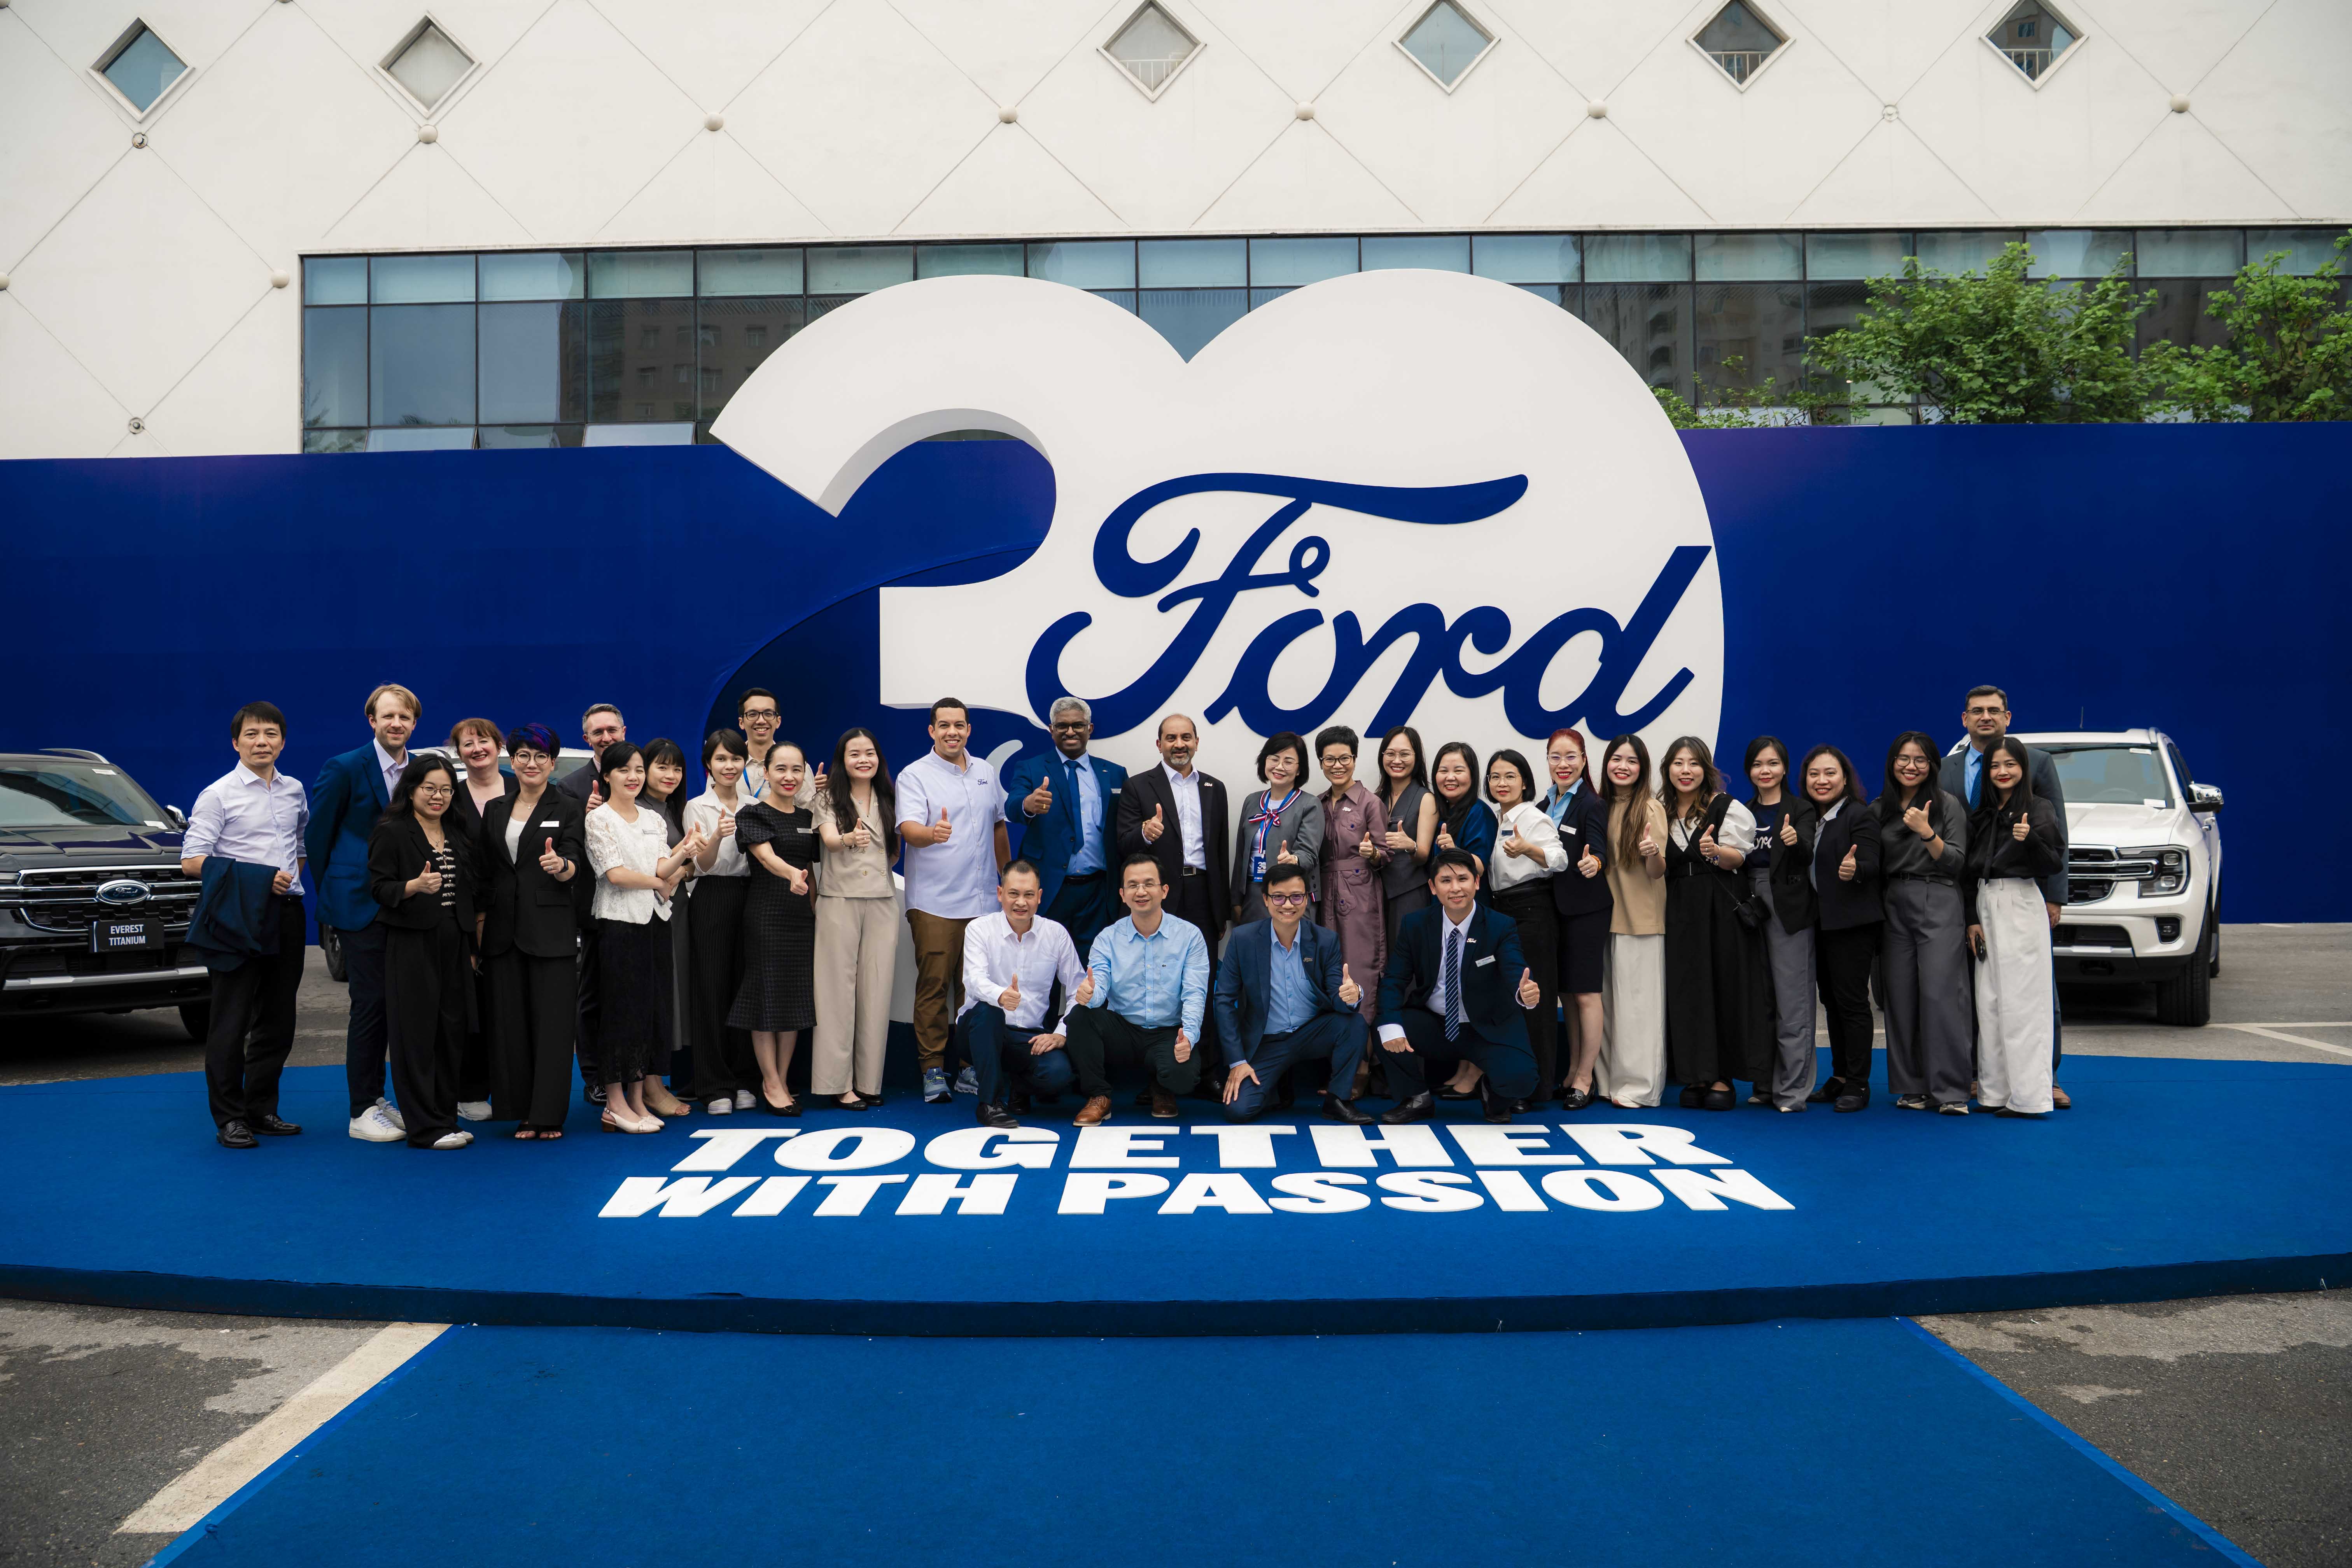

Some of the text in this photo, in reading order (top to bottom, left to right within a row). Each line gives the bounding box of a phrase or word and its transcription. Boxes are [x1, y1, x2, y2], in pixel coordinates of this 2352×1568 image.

[1026, 472, 1712, 740] Ford
[113, 887, 138, 896] Ford
[109, 936, 145, 946] TITANIUM
[110, 924, 144, 934] EVEREST
[671, 1124, 1733, 1171] TOGETHER
[598, 1169, 1795, 1217] WITH PASSION
